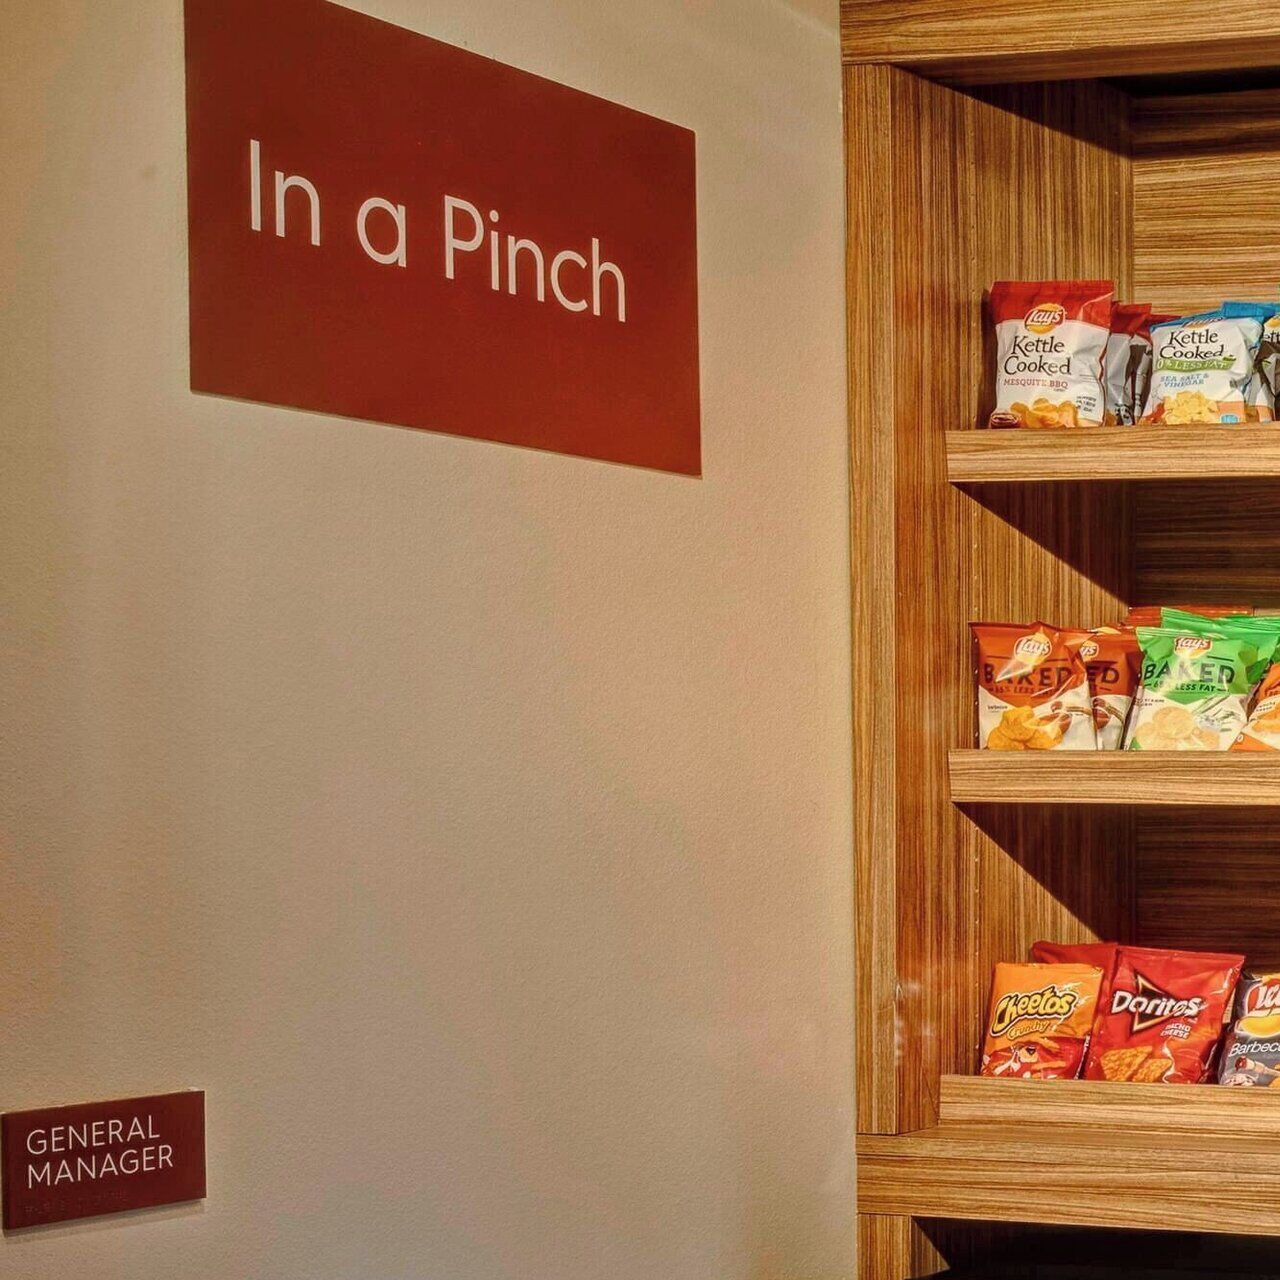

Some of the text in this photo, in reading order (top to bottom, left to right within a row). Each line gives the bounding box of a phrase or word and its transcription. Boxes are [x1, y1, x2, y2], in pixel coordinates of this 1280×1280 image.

[250, 139, 627, 323] In a Pinch
[1011, 335, 1065, 356] Kettle
[1168, 329, 1218, 346] Kettle
[1160, 344, 1224, 361] Cooked
[1003, 357, 1072, 376] Cooked
[1050, 379, 1069, 390] BBQ
[1144, 661, 1235, 685] BAKED
[1198, 683, 1216, 692] FAT
[992, 986, 1078, 1036] Cheetos
[1111, 990, 1202, 1017] Doritos
[1008, 1021, 1049, 1040] Crunchy
[26, 1114, 161, 1155] GENERAL
[28, 1144, 174, 1190] MANAGER
